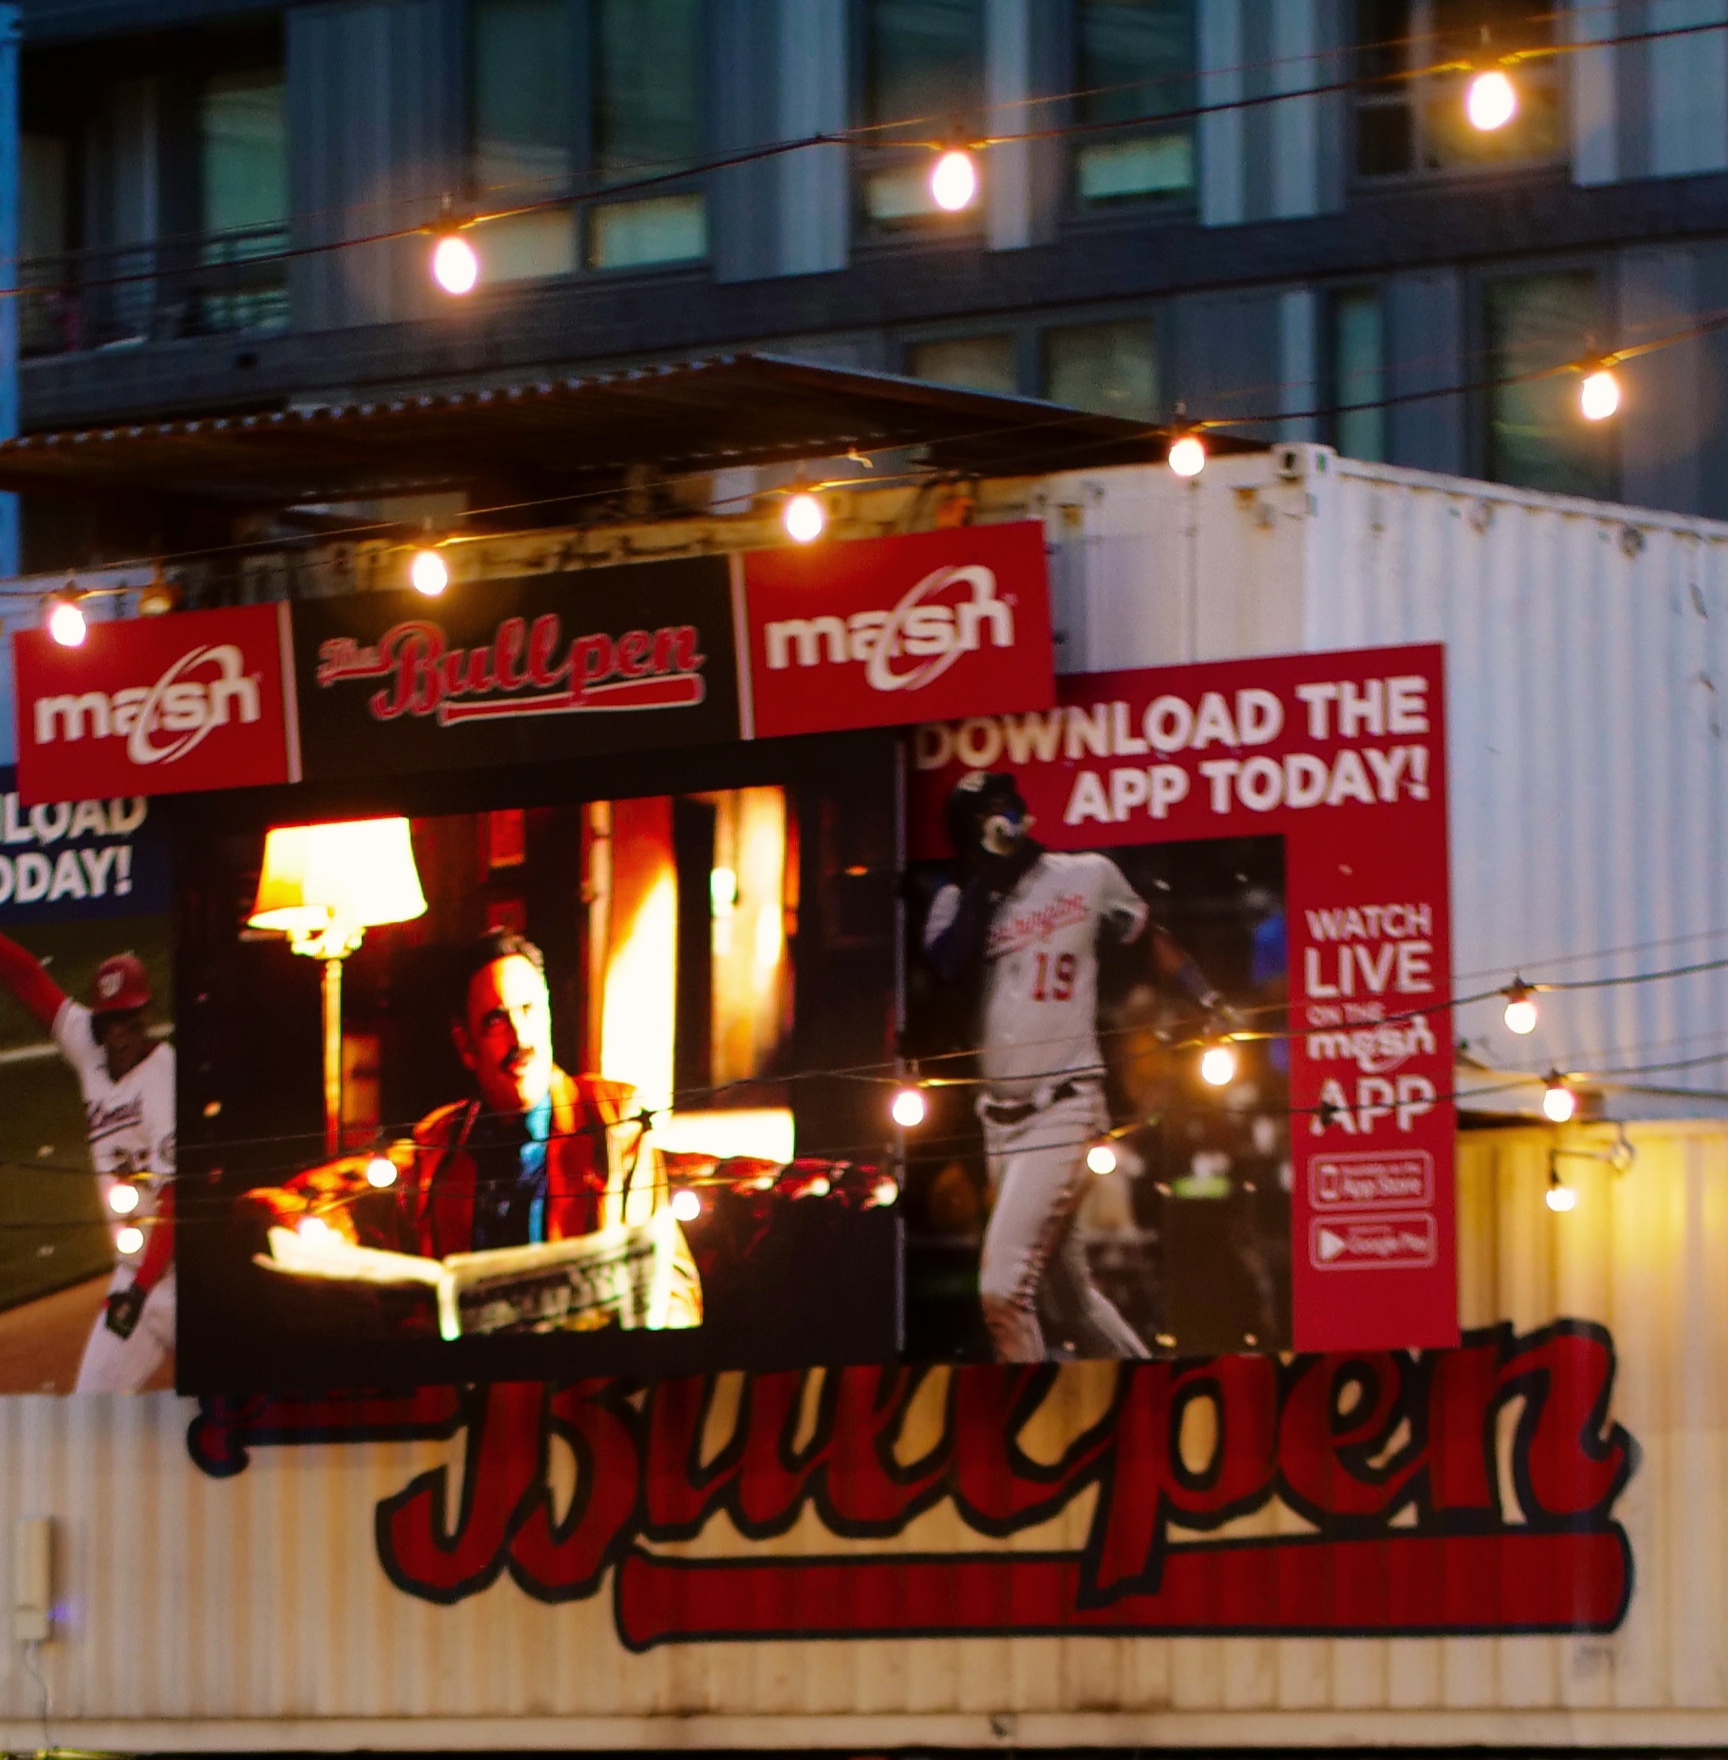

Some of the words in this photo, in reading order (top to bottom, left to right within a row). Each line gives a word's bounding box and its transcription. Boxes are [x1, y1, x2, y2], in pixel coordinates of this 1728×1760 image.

[371, 613, 707, 720] Bullpen
[913, 689, 1285, 770] DOWNLOAD
[1296, 676, 1430, 740] THE
[1064, 762, 1190, 825] APP
[1199, 745, 1430, 811] TODAY!
[1305, 903, 1432, 941] WATCH
[1032, 953, 1075, 1001] 19
[1305, 941, 1434, 999] LIVE
[1306, 1004, 1343, 1026] ON
[1309, 1074, 1438, 1137] APP
